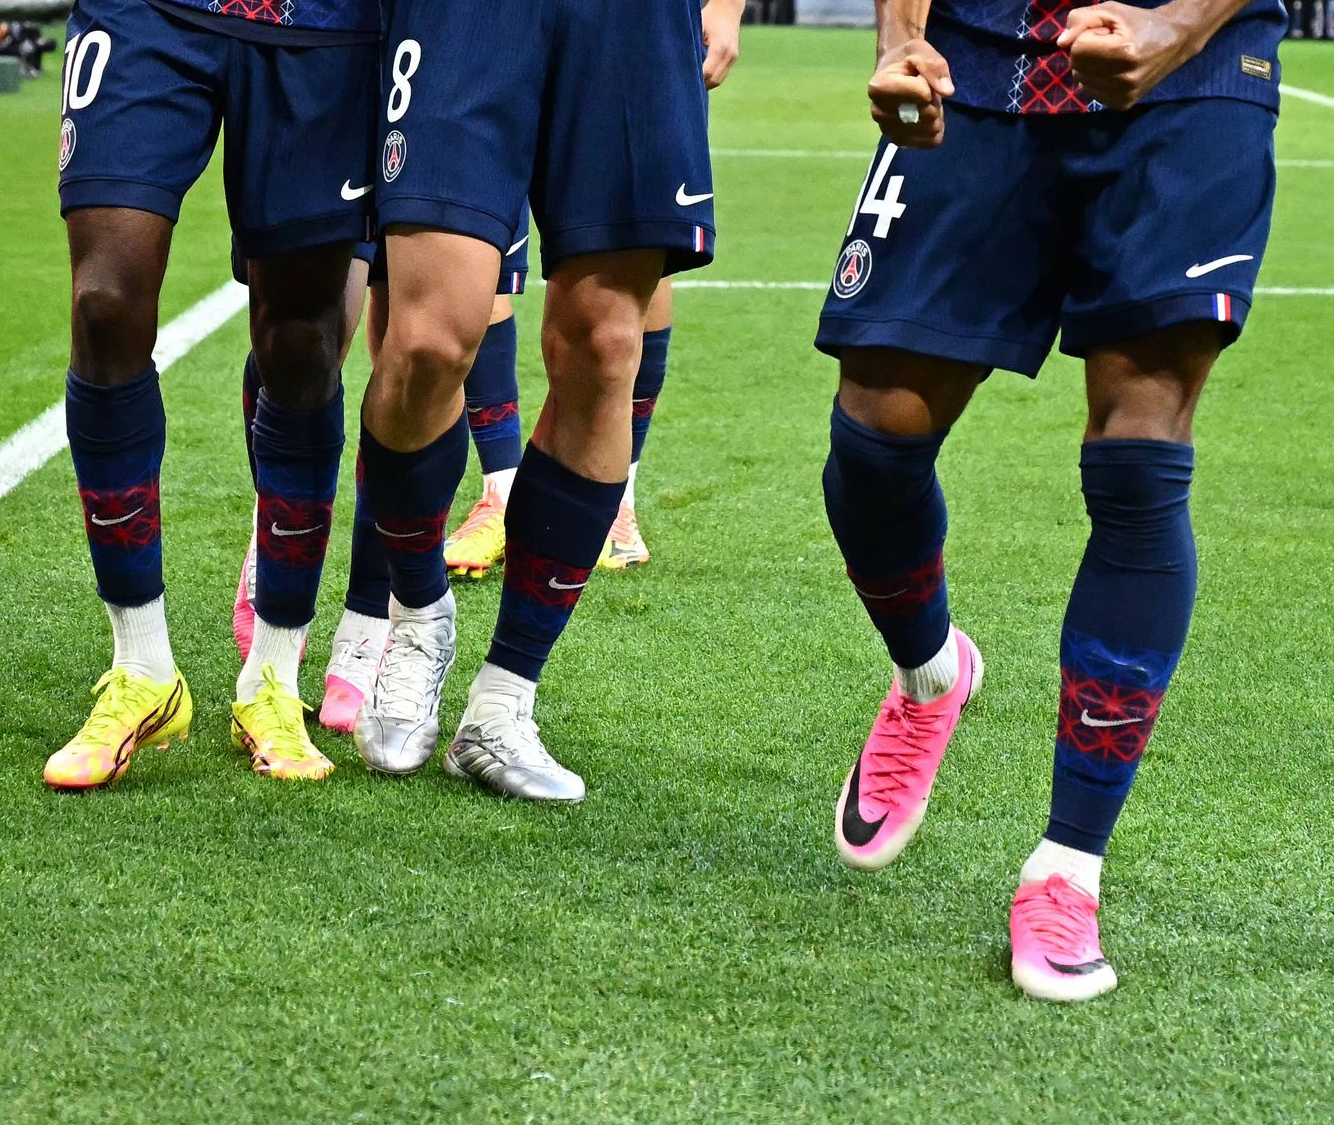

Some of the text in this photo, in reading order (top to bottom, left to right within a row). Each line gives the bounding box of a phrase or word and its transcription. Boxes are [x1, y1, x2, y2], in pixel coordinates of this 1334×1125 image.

[62, 30, 111, 116] 10
[387, 39, 421, 123] 8
[845, 242, 868, 257] PARIS
